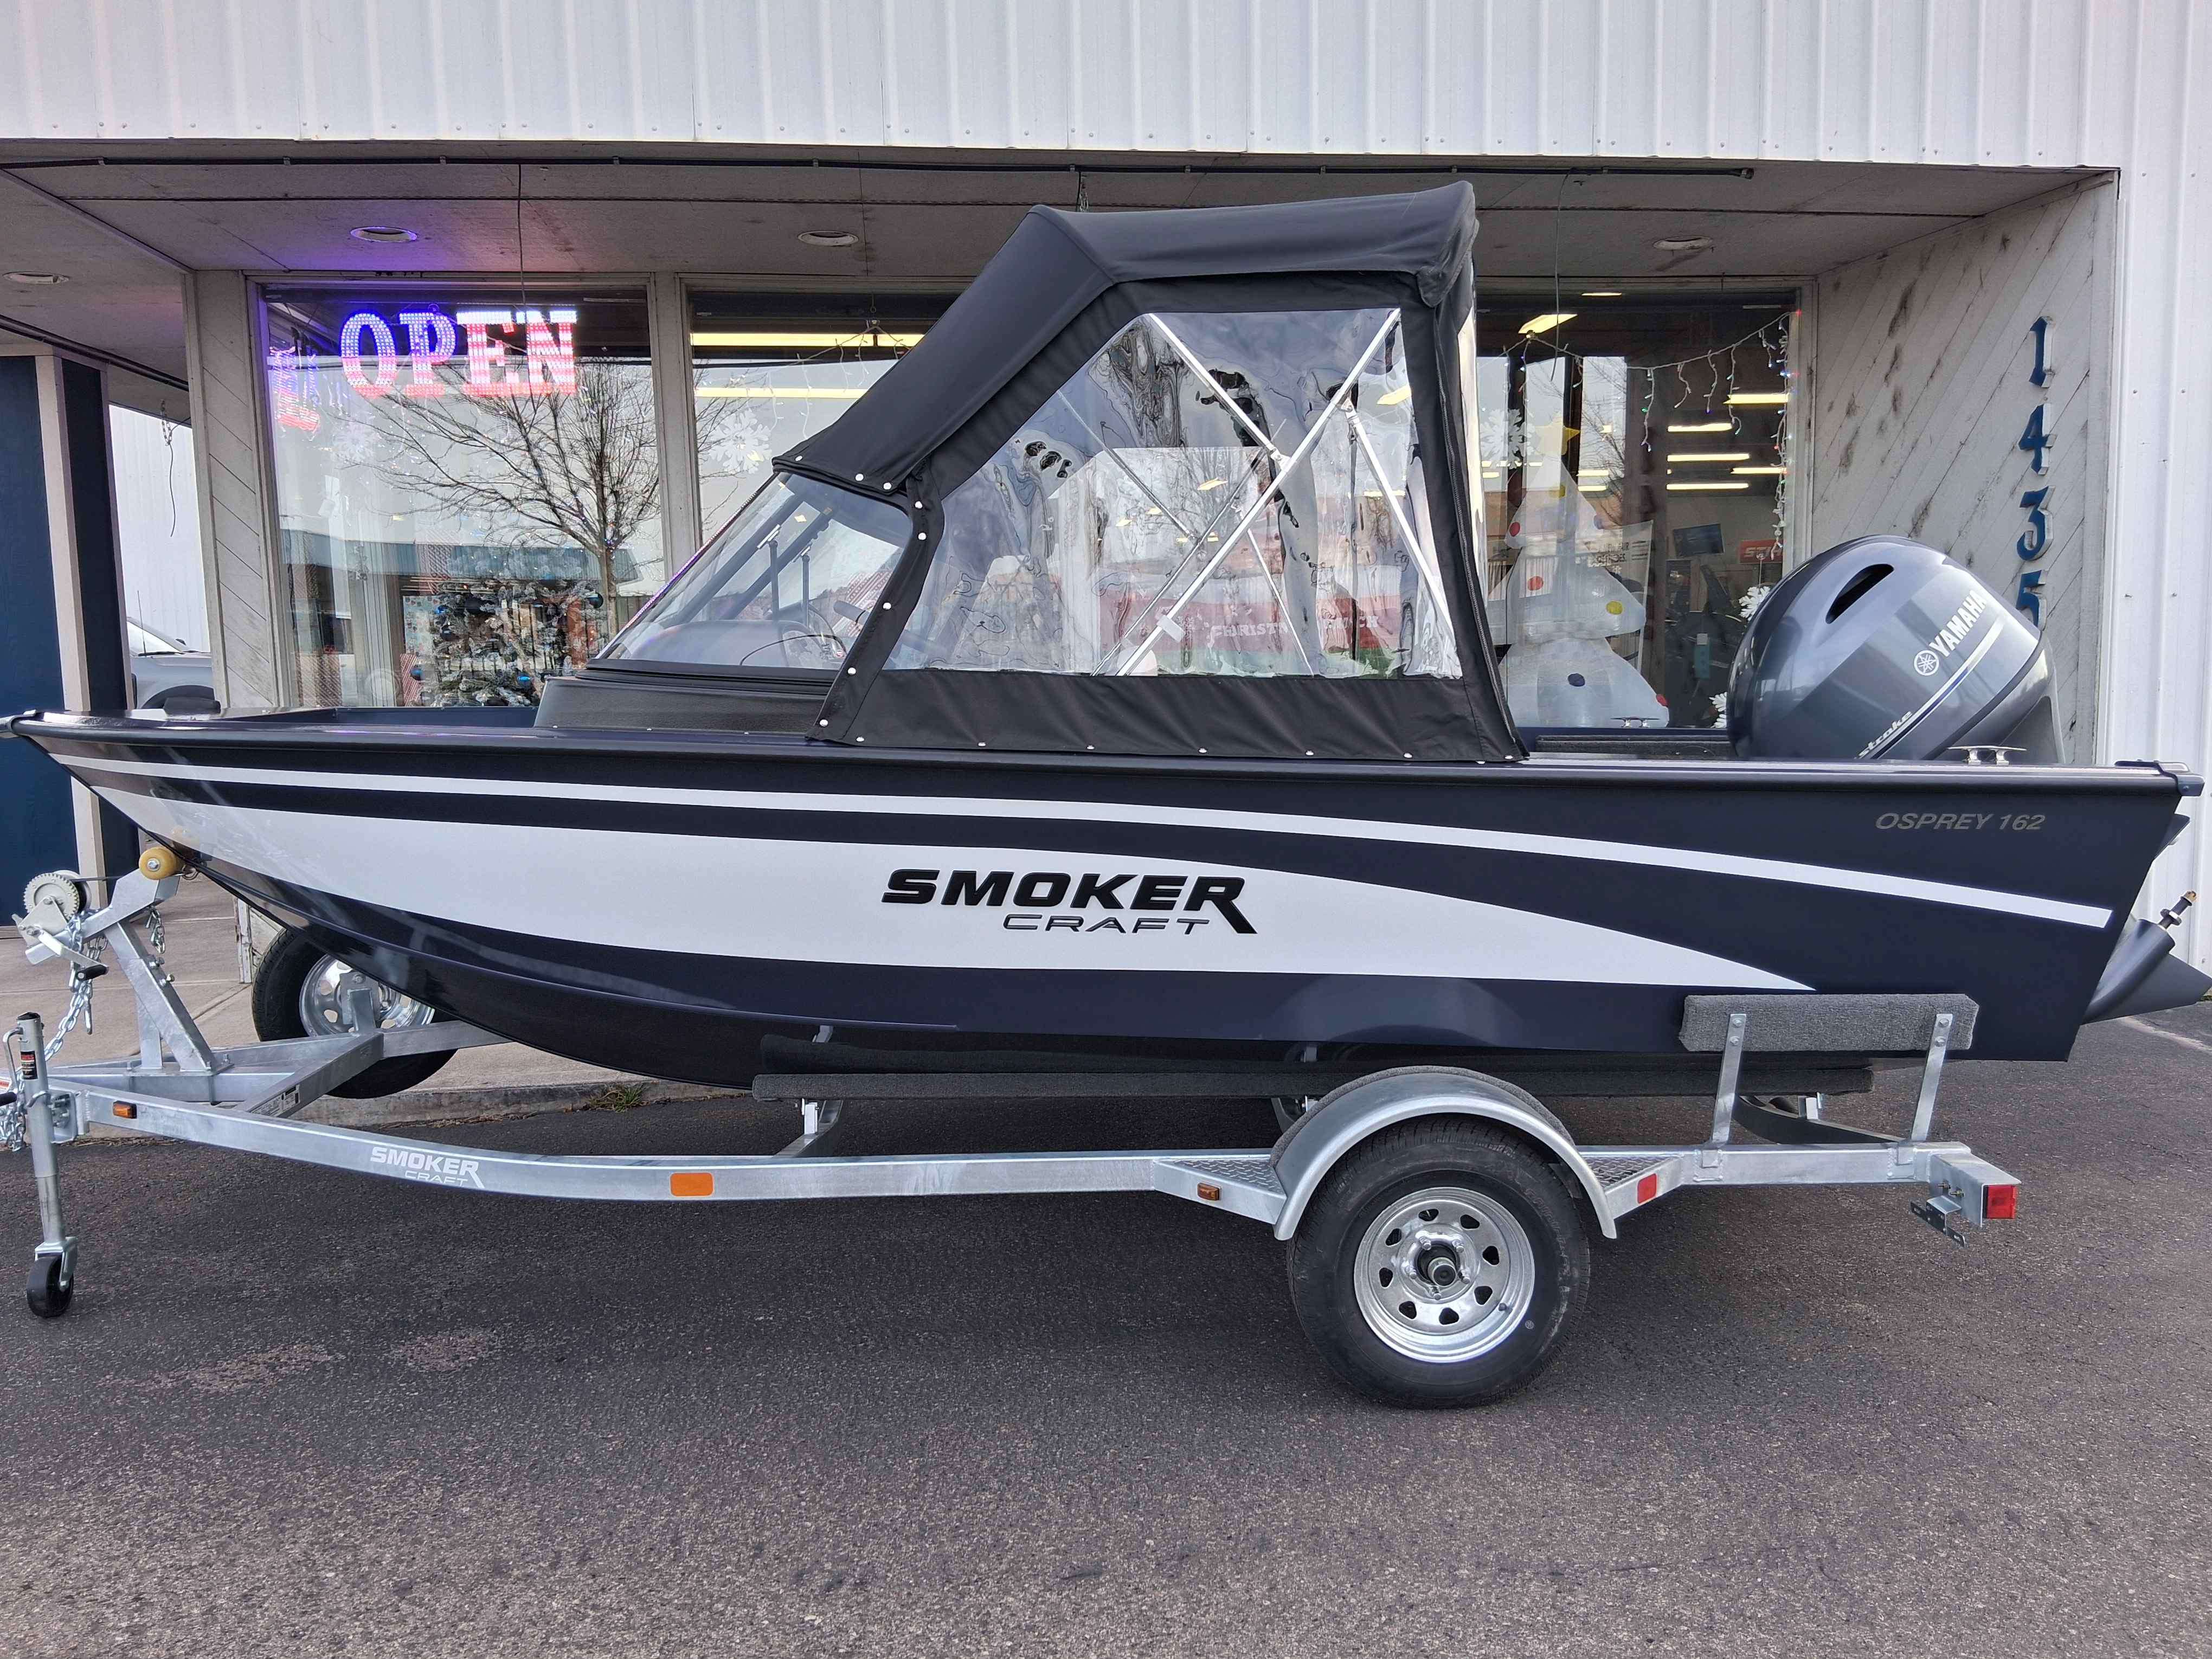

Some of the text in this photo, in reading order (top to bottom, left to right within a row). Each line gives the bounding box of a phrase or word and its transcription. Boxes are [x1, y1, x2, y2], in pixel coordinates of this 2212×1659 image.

[340, 311, 577, 397] OPEN
[1929, 589, 1988, 657] YAMAHA
[1875, 813, 2046, 831] OSPREY 162
[881, 868, 1258, 934] SMOKER
[1002, 914, 1210, 935] CRAFT
[370, 1146, 485, 1188] SMOKER
[404, 1170, 468, 1187] CRAFT
